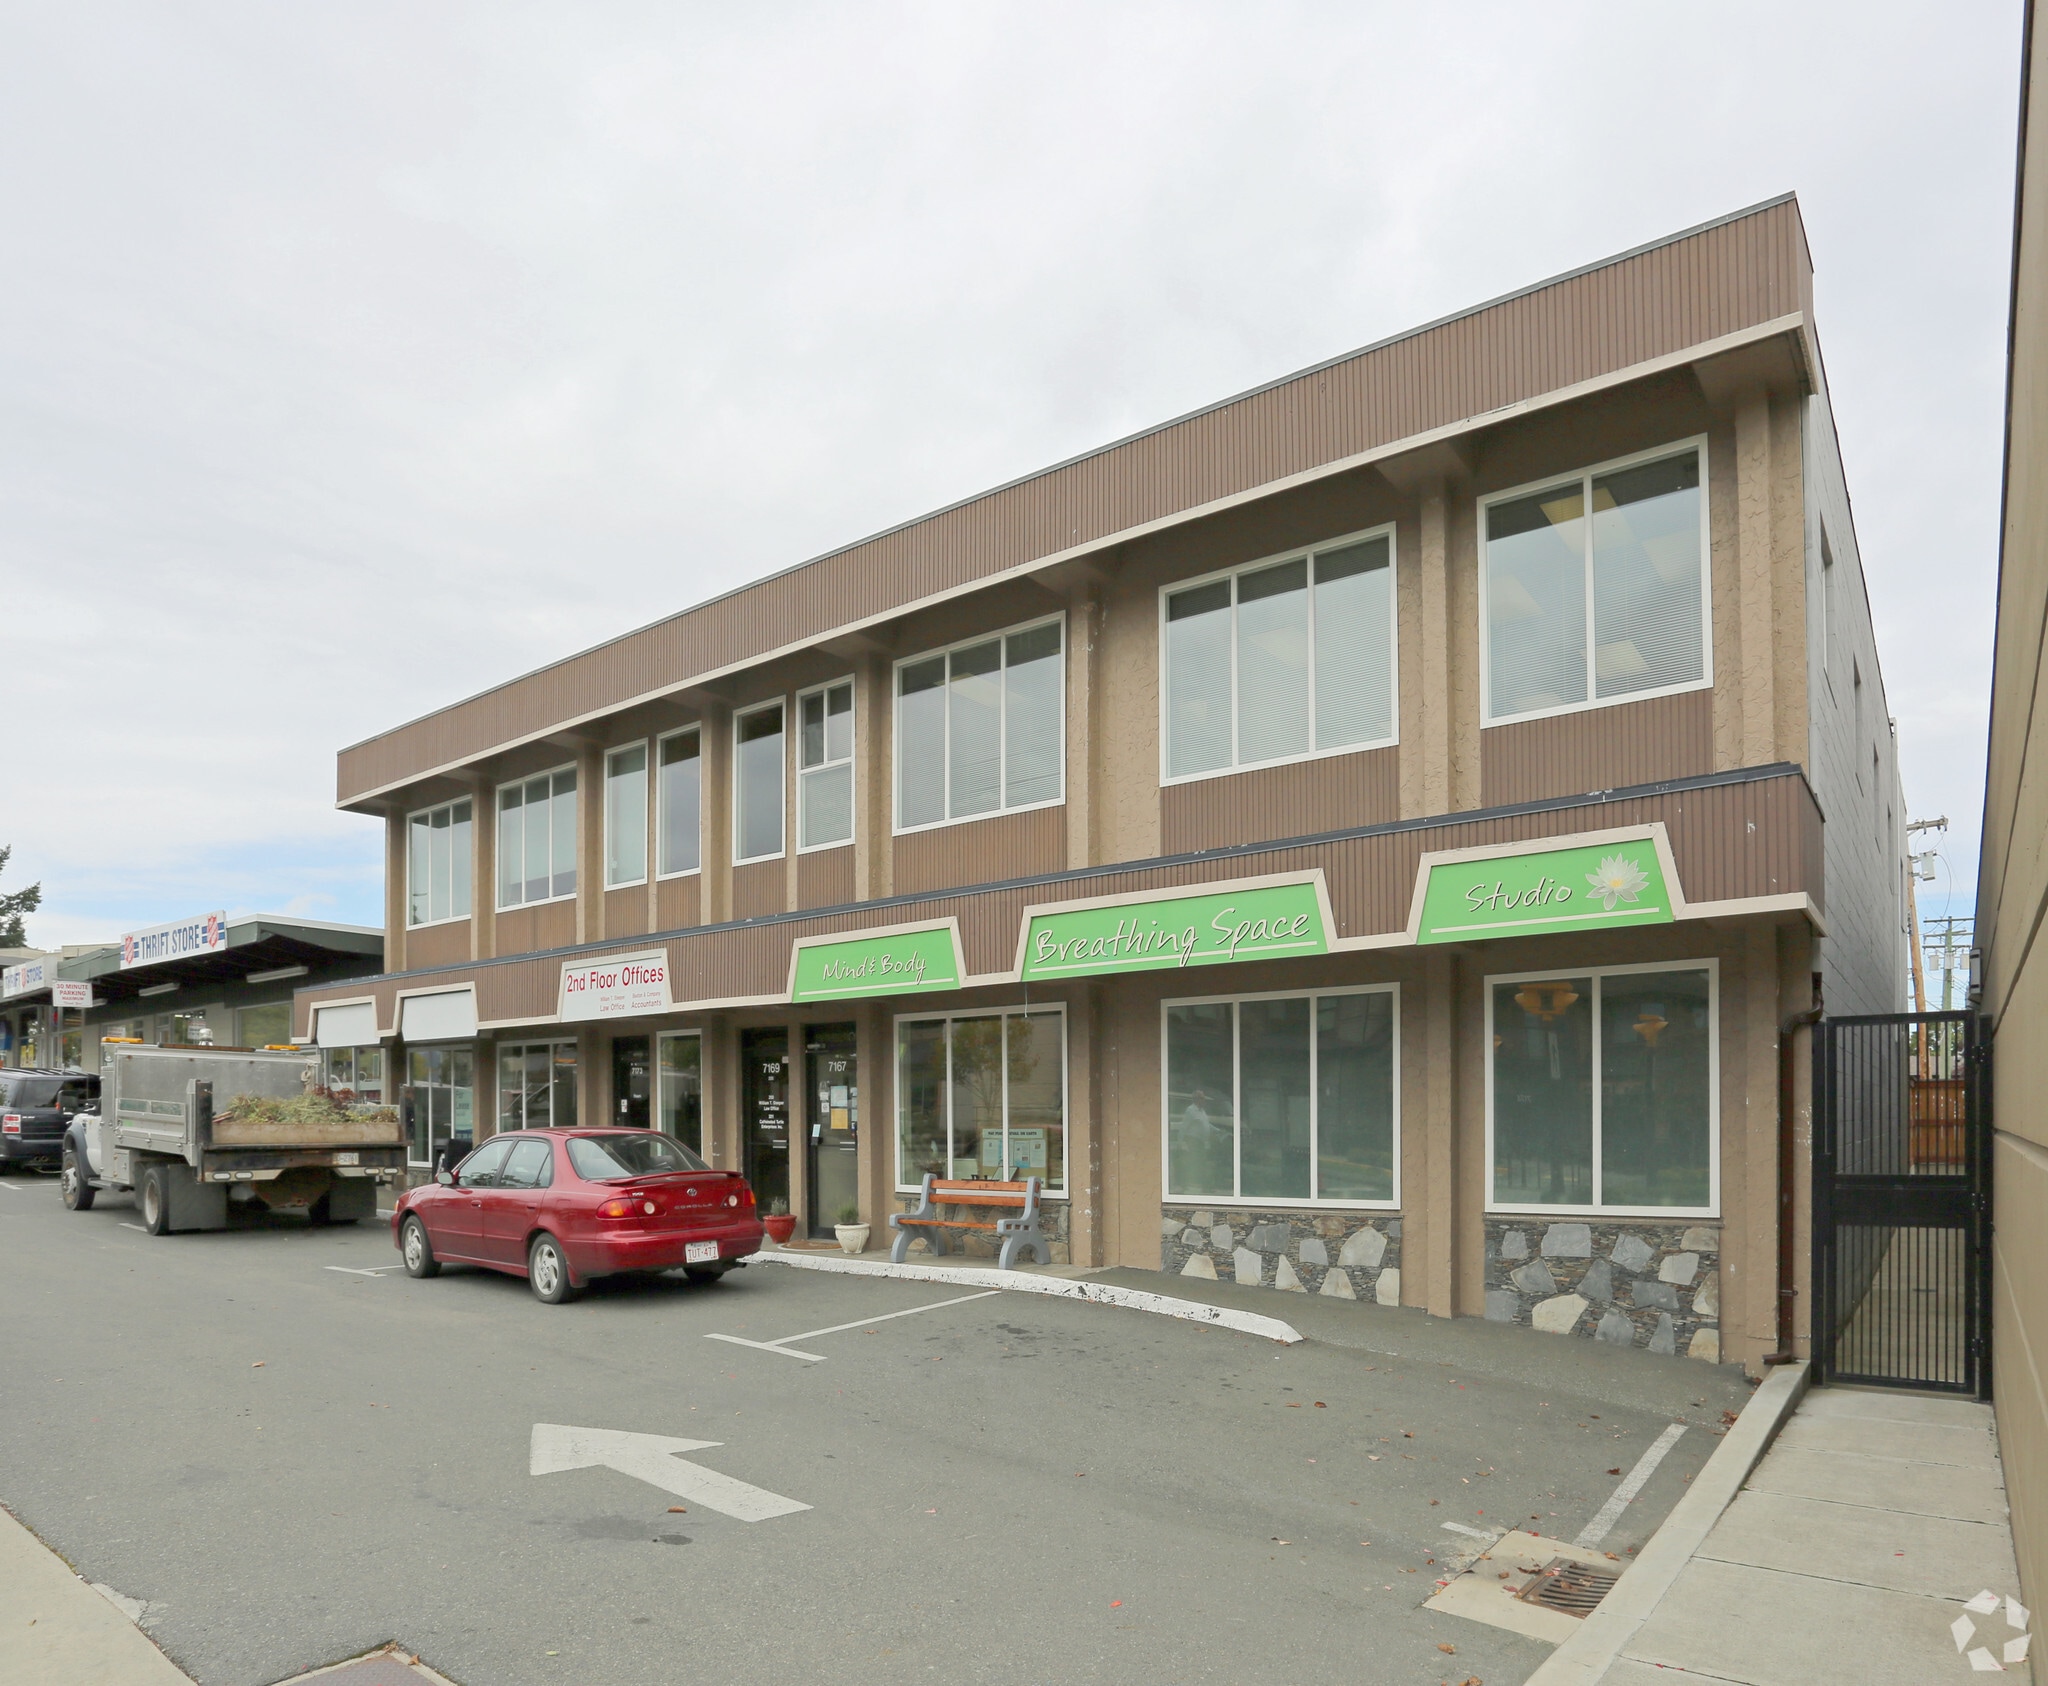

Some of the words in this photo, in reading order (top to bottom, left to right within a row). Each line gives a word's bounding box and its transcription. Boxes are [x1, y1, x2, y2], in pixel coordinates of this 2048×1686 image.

[1465, 876, 1573, 912] Studio
[141, 931, 169, 960] THRIFT
[172, 924, 200, 954] STORE
[1034, 918, 1200, 968] Breathing
[1211, 907, 1311, 960] Space
[567, 973, 586, 992] 2nd
[590, 971, 618, 990] Floor
[622, 966, 664, 986] Offices
[822, 956, 868, 982] Mind
[880, 950, 926, 985] Body
[631, 1000, 662, 1009] Accountants
[763, 1063, 780, 1073] 7169
[828, 1061, 846, 1072] 7167
